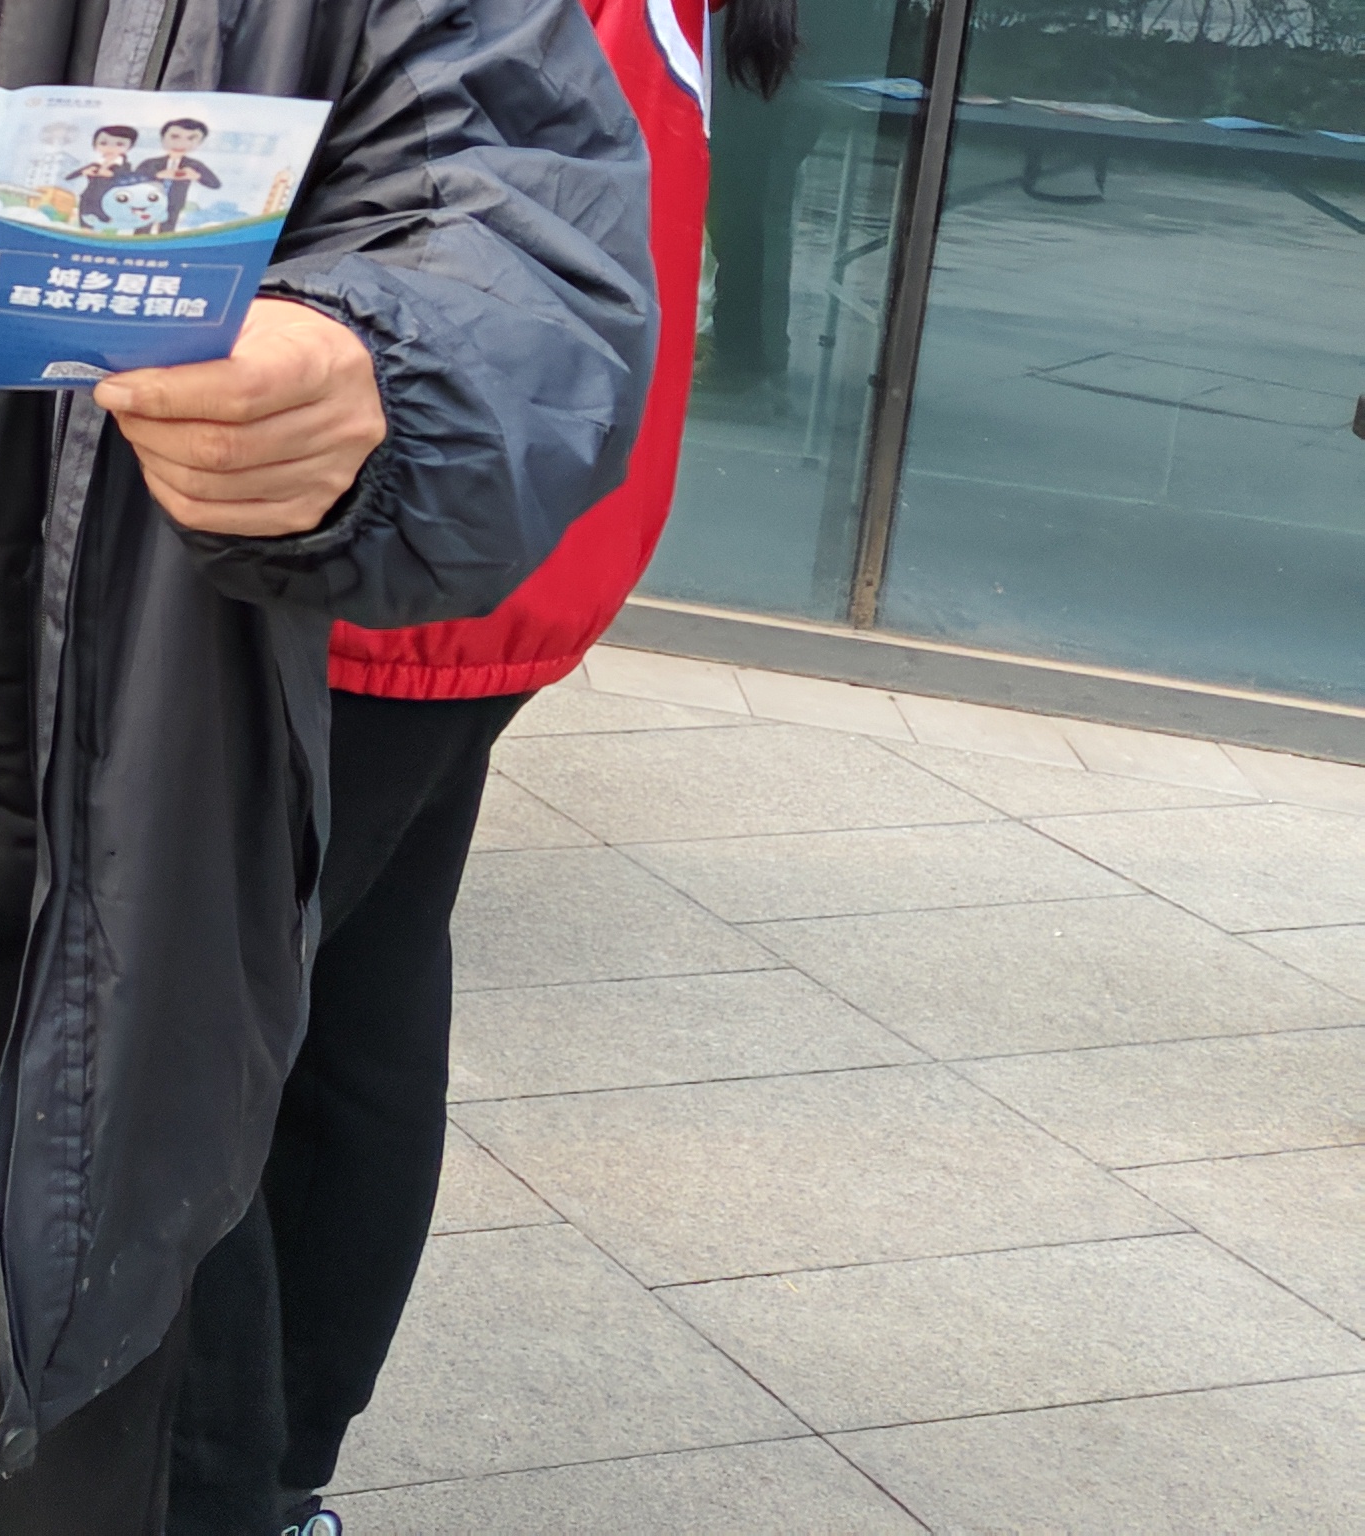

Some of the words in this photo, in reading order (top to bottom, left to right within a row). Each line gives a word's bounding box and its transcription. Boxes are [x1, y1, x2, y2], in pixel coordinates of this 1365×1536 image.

[47, 266, 182, 296] 城乡居民
[8, 285, 209, 317] 基本养老保险
